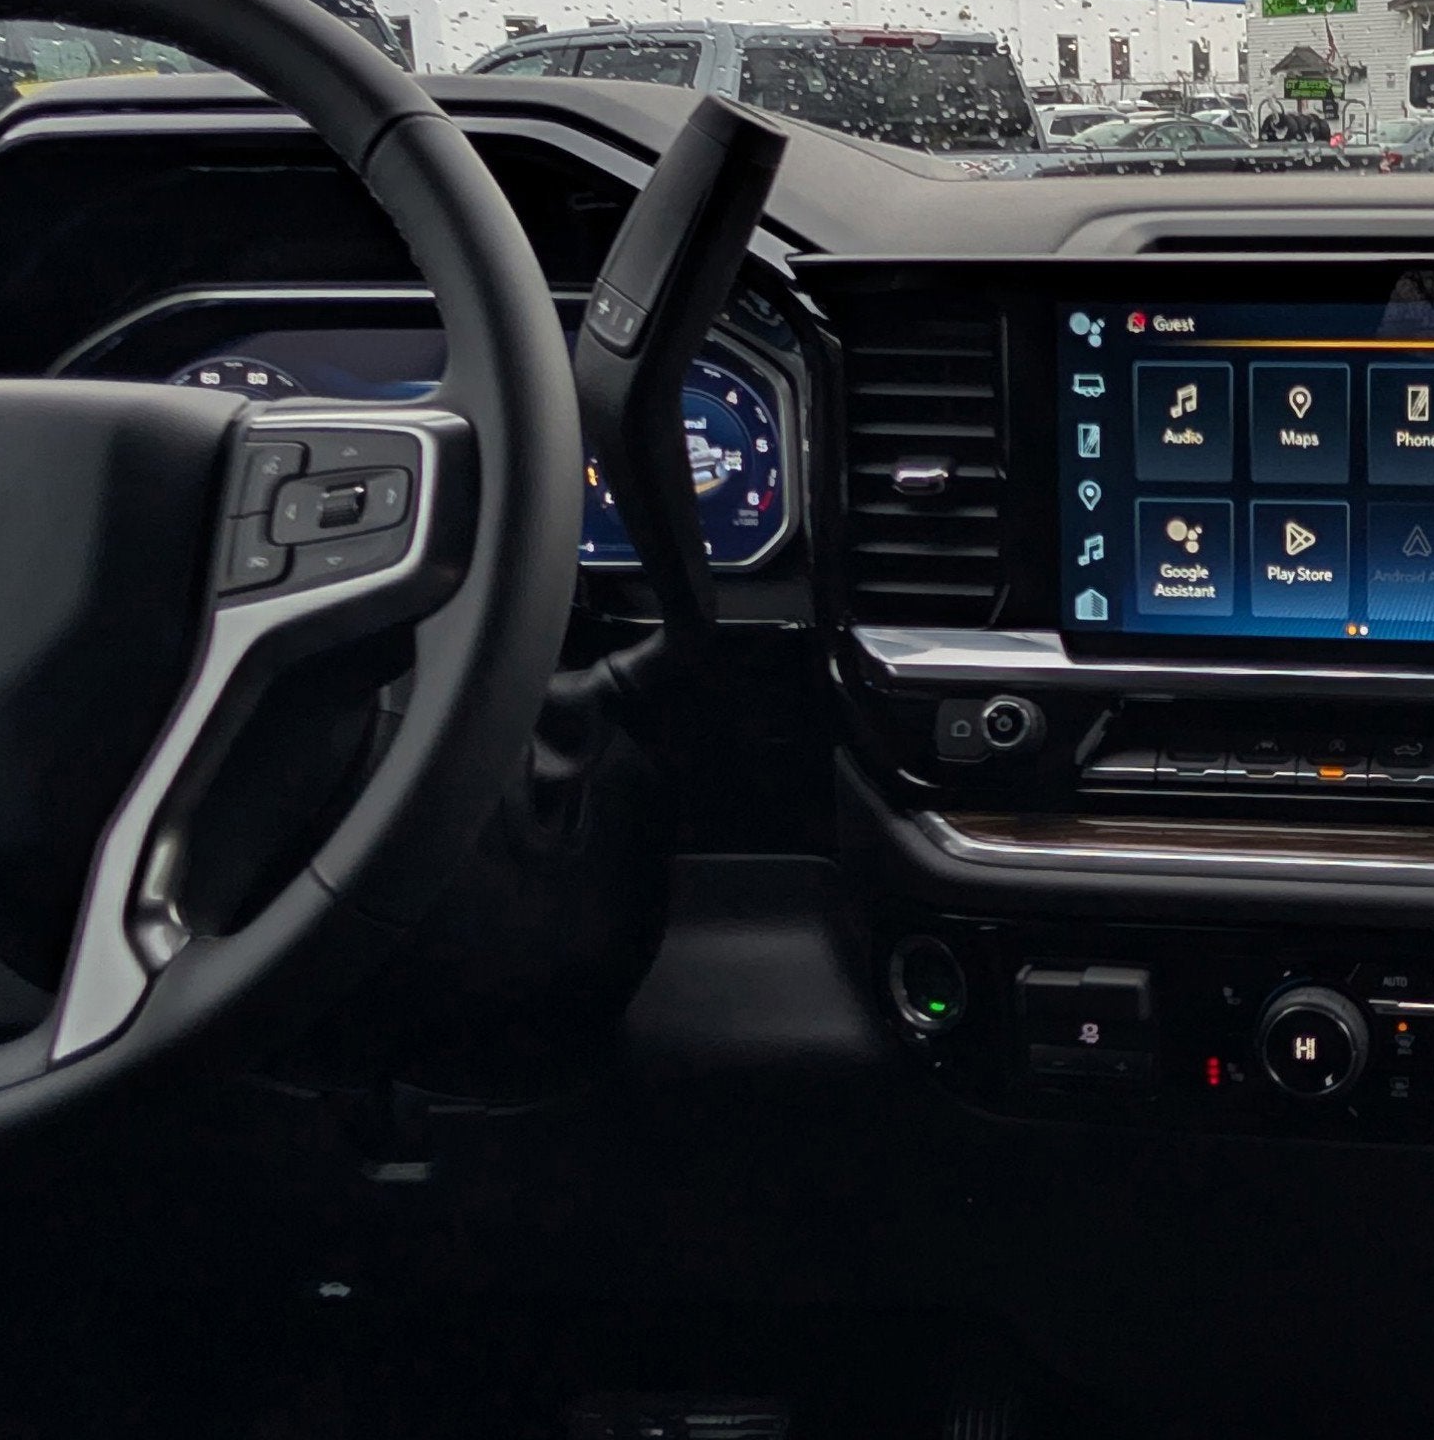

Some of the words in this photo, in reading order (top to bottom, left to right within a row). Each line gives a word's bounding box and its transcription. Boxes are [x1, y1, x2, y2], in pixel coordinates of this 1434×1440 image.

[1153, 314, 1195, 335] Guest
[1164, 428, 1204, 446] Audio
[1280, 430, 1320, 448] Maps
[1160, 564, 1209, 582] Google
[1267, 566, 1297, 584] Play
[1300, 566, 1333, 582] Store
[1373, 570, 1425, 585] Android
[1154, 583, 1216, 600] Assistant
[1383, 976, 1408, 988] AUTO
